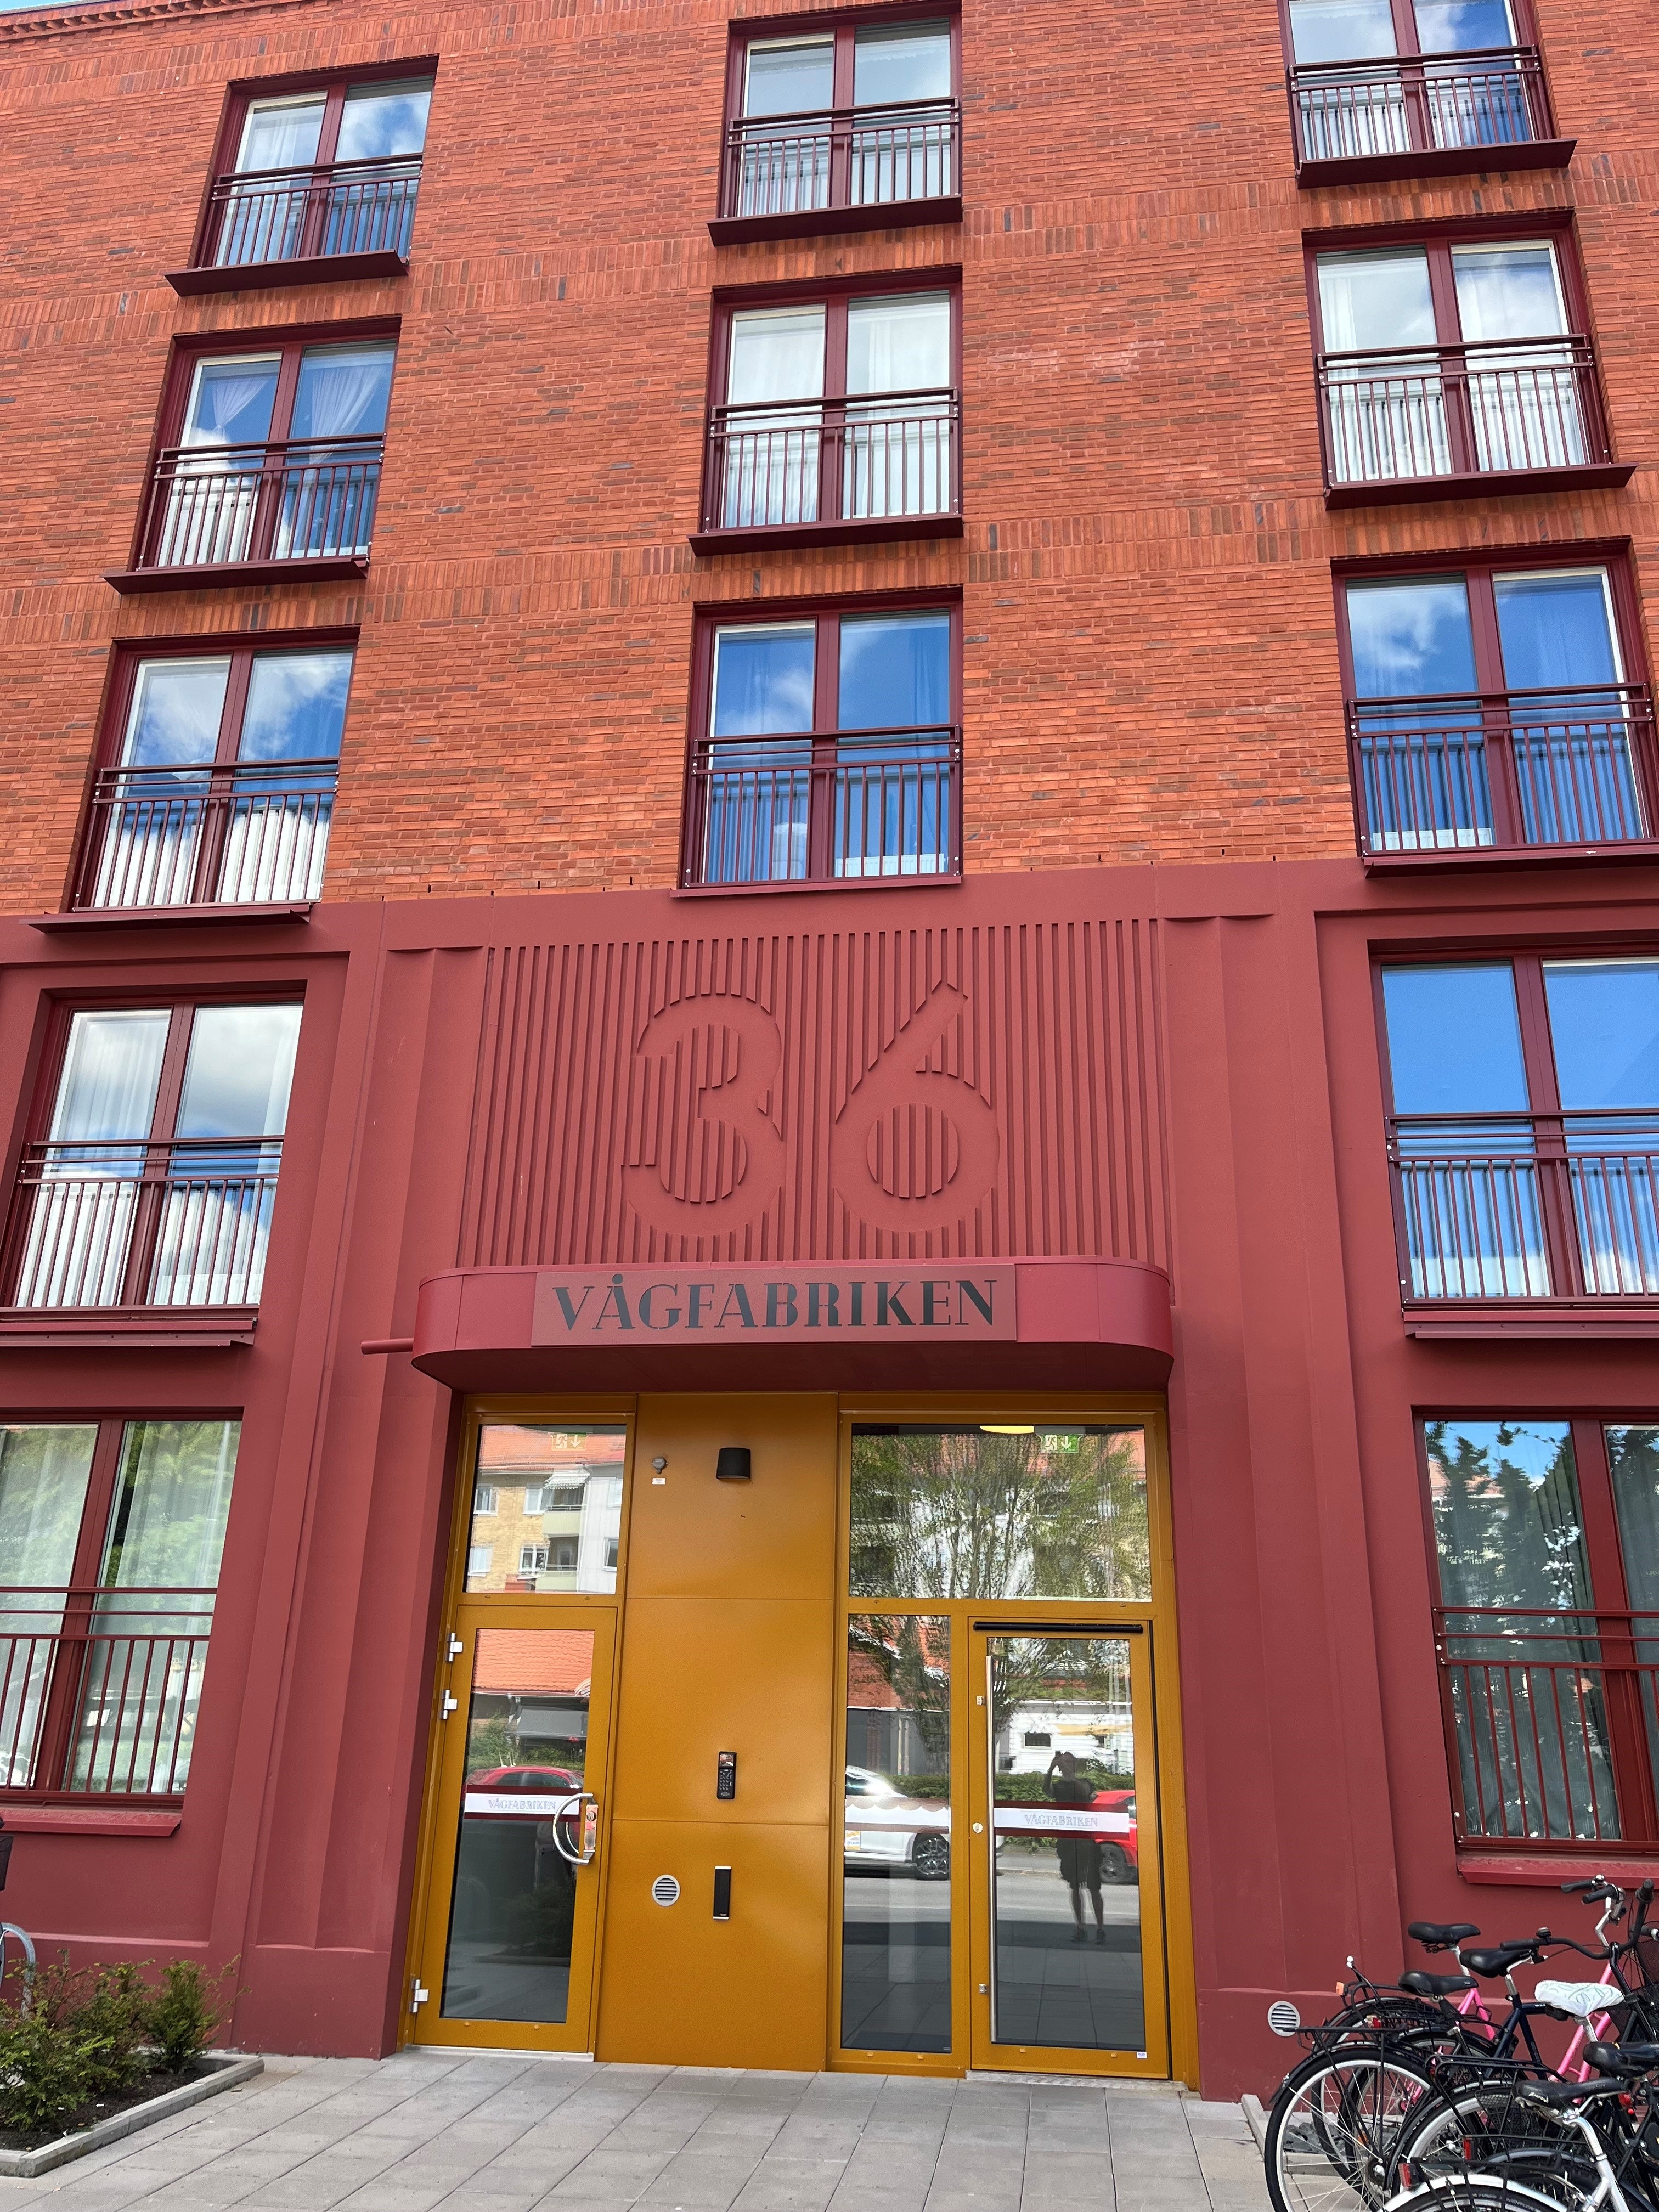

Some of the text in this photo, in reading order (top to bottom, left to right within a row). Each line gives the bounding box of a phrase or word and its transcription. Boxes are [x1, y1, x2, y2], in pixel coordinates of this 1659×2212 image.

[620, 979, 1001, 1237] 36
[552, 1273, 997, 1330] VÅGFABRIKEN
[488, 1797, 556, 1810] VÅGFABRIKEN
[1024, 1813, 1098, 1827] VÅGFABRIKEN
